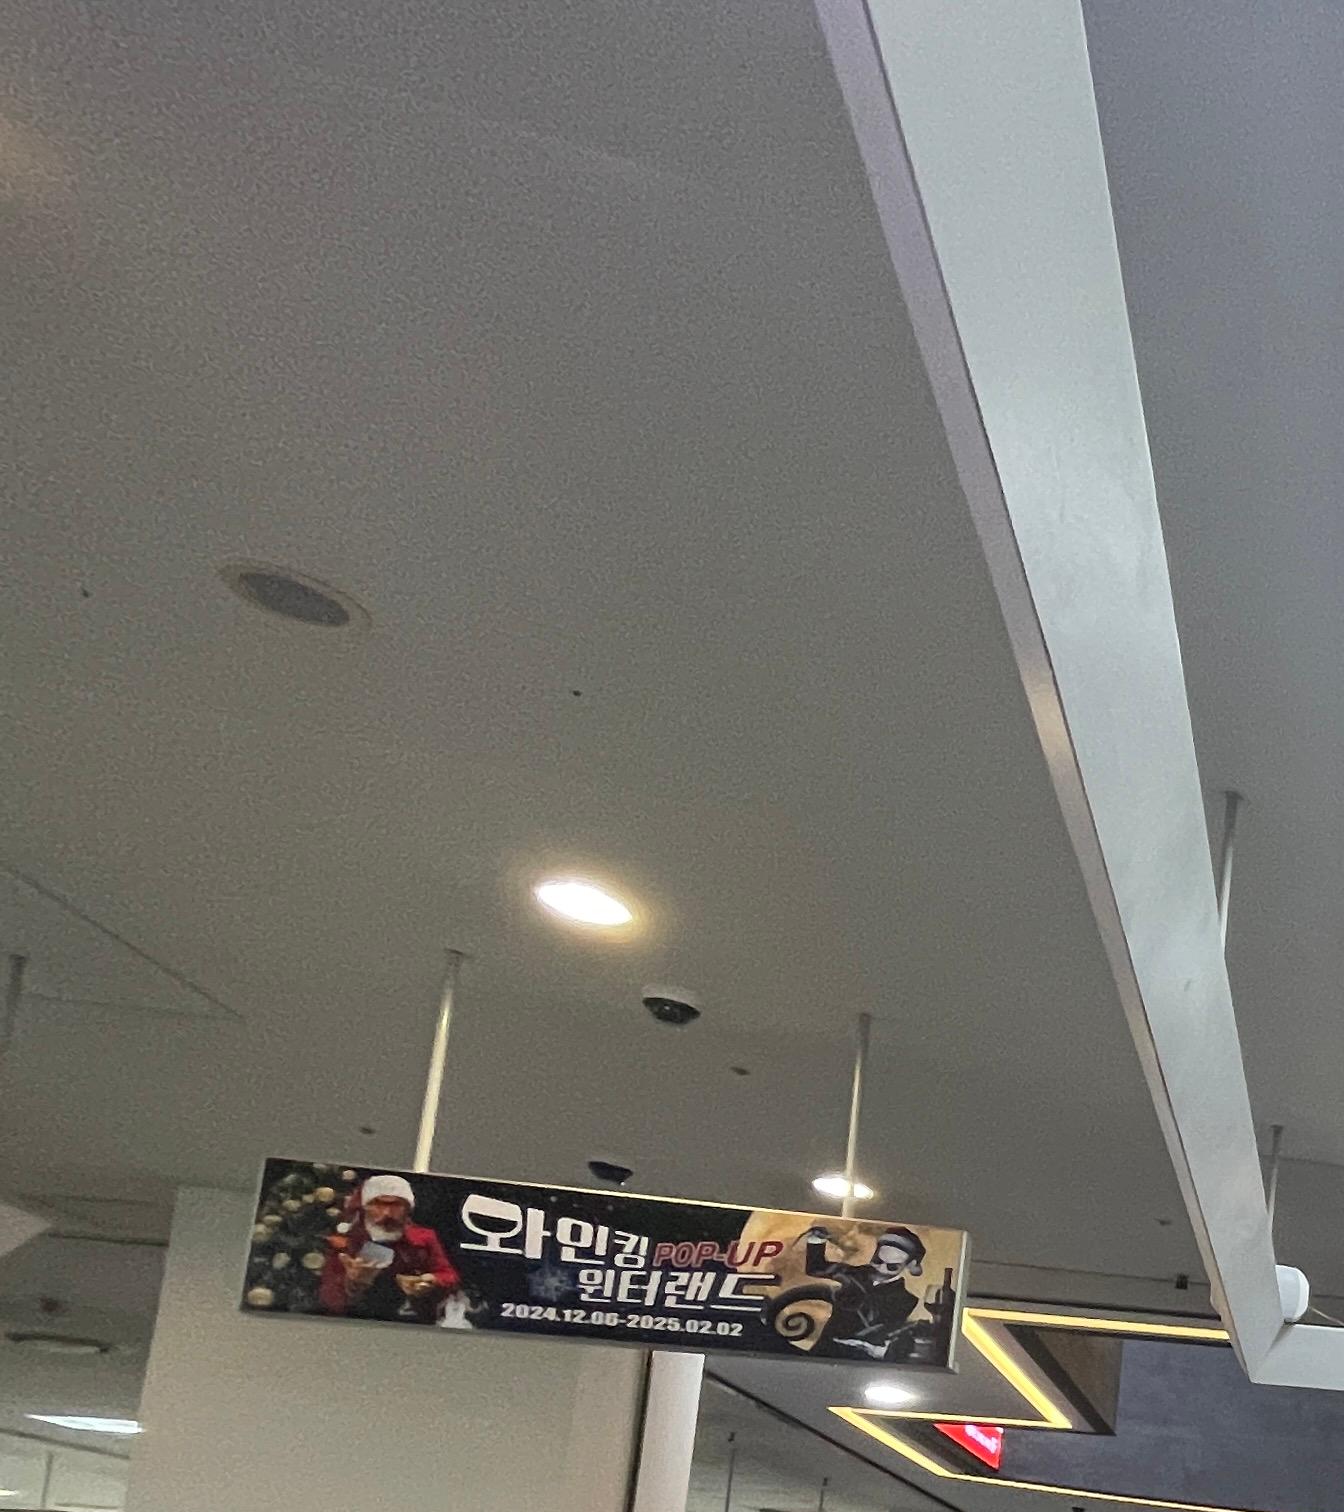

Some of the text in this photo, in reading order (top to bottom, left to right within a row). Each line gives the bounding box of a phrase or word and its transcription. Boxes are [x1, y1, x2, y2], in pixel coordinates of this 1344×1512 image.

[460, 1194, 785, 1269] 와인킹 POP-UP
[578, 1268, 776, 1312] 윈터랜드
